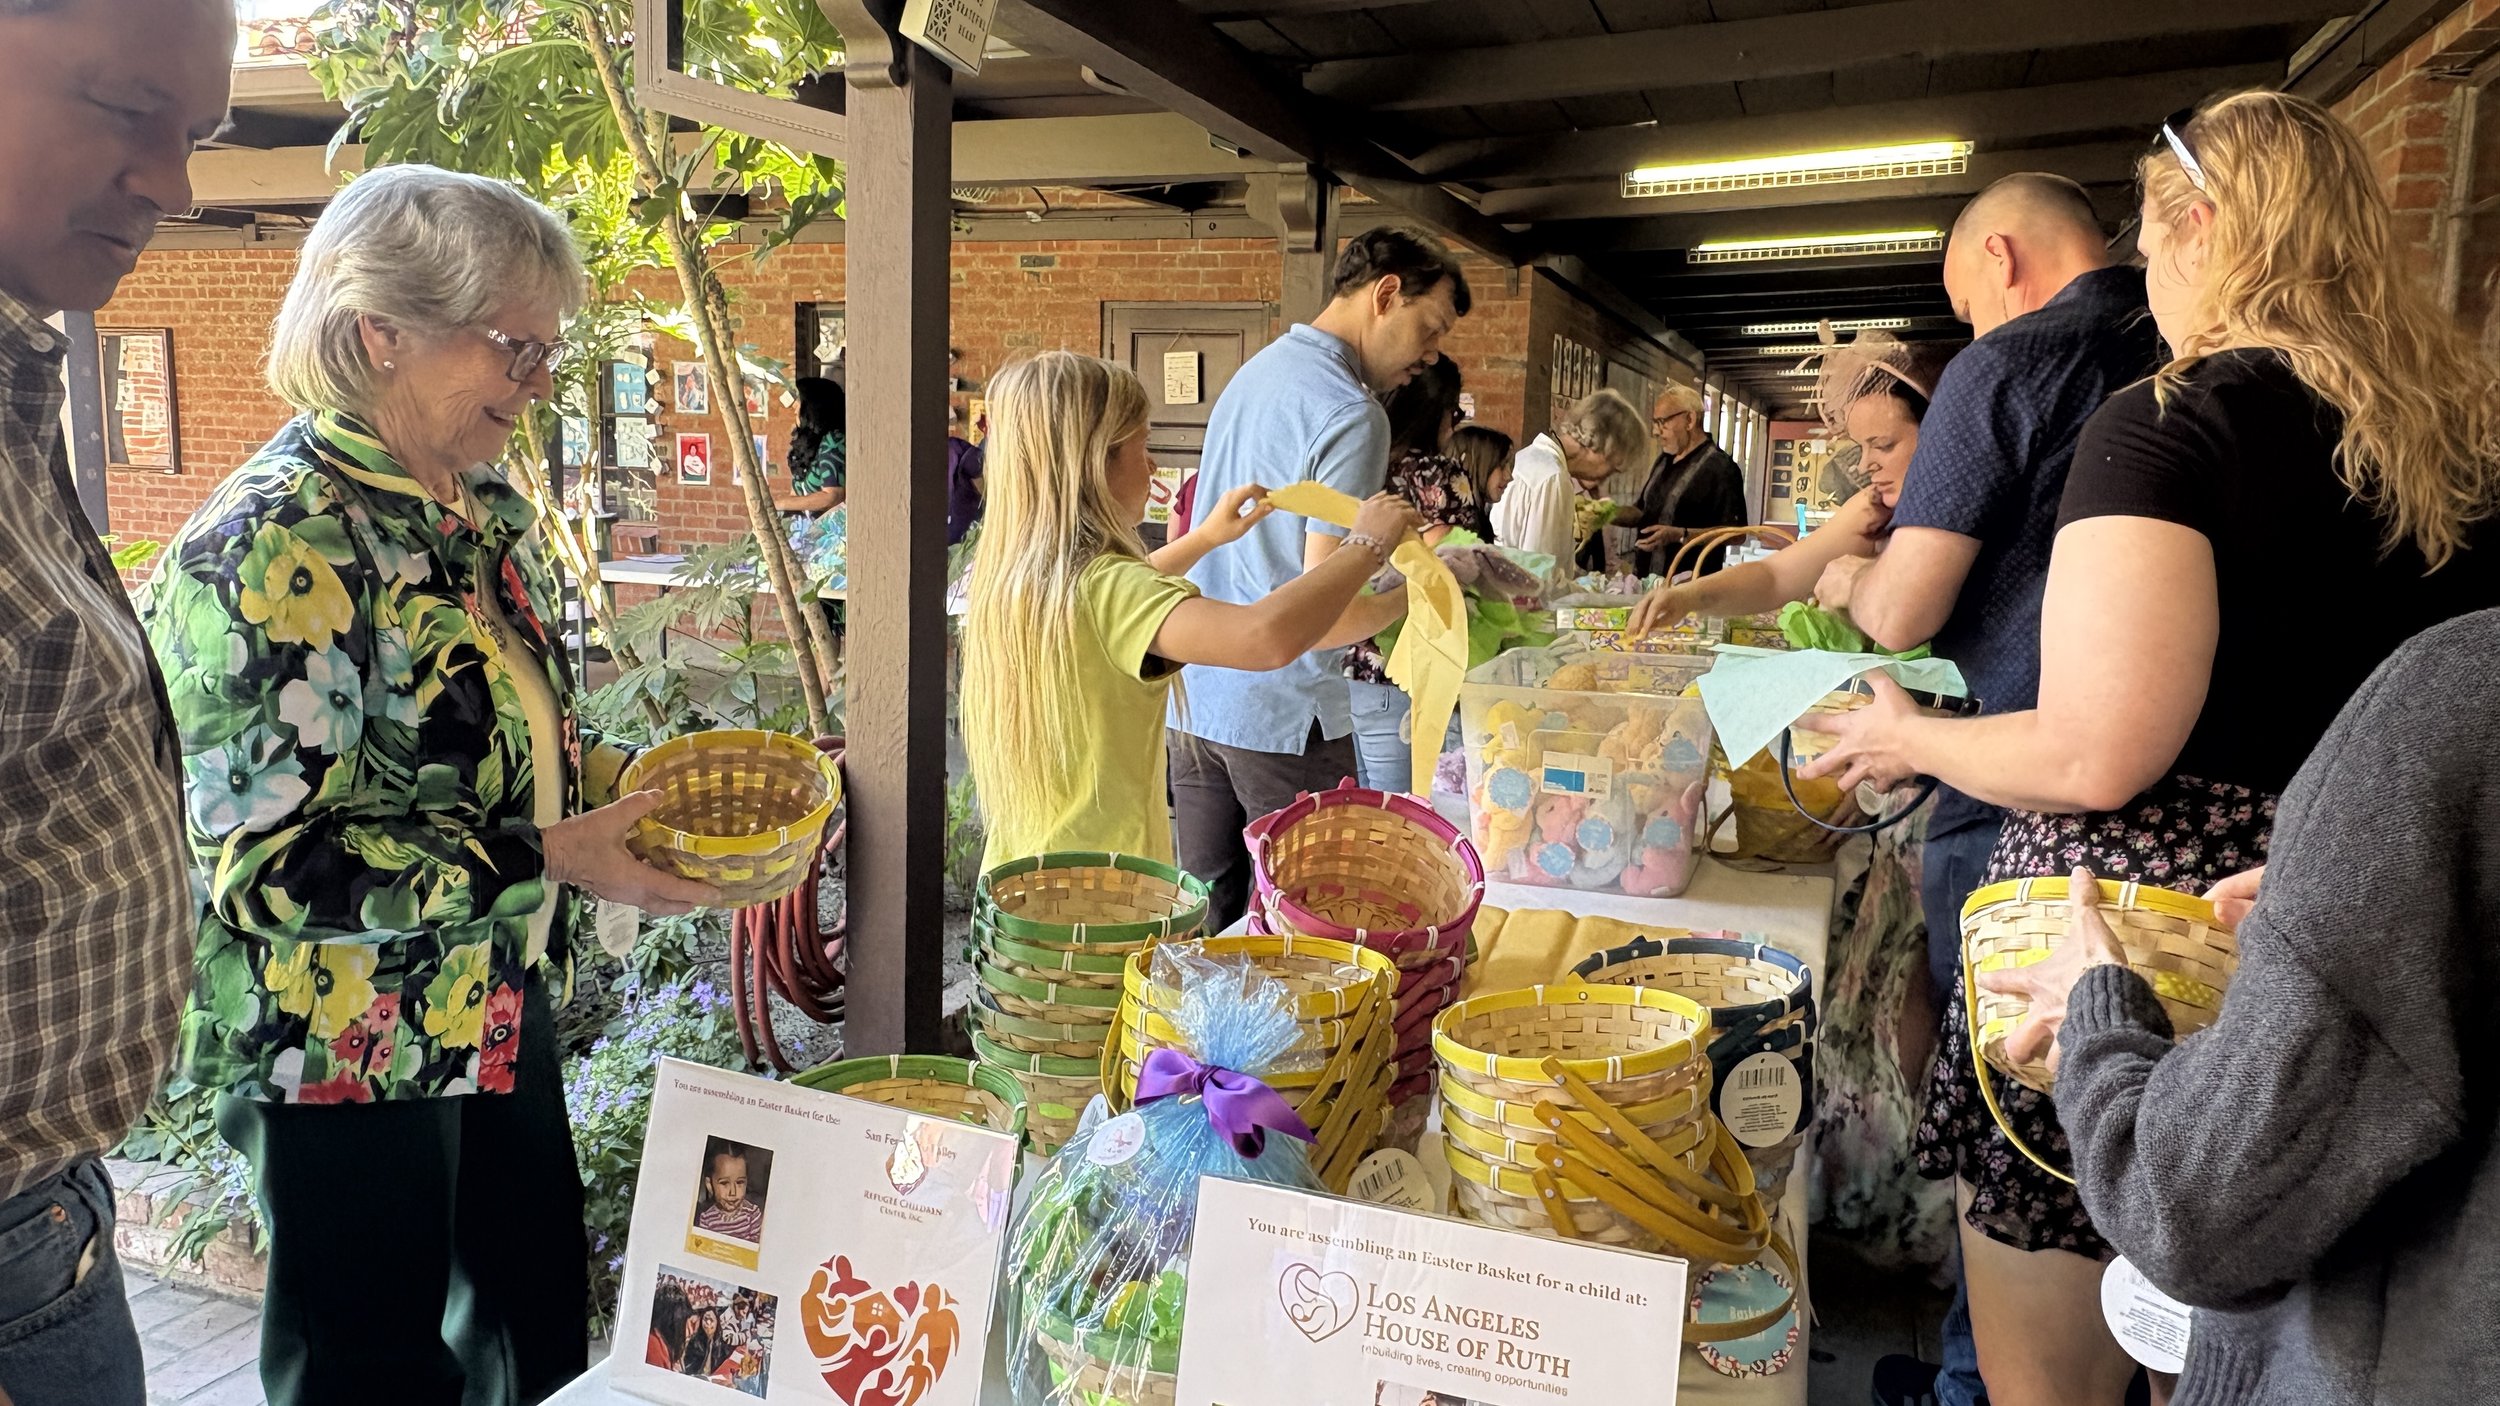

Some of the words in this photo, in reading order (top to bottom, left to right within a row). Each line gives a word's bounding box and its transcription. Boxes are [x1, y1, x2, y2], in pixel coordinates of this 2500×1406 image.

[674, 1079, 688, 1091] You
[690, 1085, 702, 1094] are
[703, 1087, 745, 1106] assembling
[746, 1097, 756, 1106] an
[758, 1098, 783, 1112] Easter
[784, 1104, 810, 1119] Basket
[812, 1110, 825, 1122] for
[865, 1128, 882, 1142] San
[864, 1190, 898, 1206] REFUGEE
[1249, 1217, 1276, 1235] You
[1280, 1226, 1304, 1240] are
[1308, 1232, 1395, 1260] assembling
[1397, 1249, 1417, 1262] an
[1422, 1251, 1473, 1273] Easter
[1477, 1261, 1531, 1285] Basket
[1536, 1273, 1561, 1289] for
[1564, 1282, 1574, 1293] a
[1579, 1282, 1621, 1301] child
[1625, 1293, 1648, 1307] at:
[1366, 1282, 1416, 1315] LOS
[1422, 1294, 1540, 1341] ANGELES
[1361, 1343, 1413, 1366] rebuilding
[1416, 1353, 1444, 1372] lives,
[1447, 1362, 1491, 1382] creating
[1494, 1371, 1569, 1397] opportunities
[1364, 1311, 1450, 1354] HOUSE
[1456, 1337, 1490, 1361] OF
[1495, 1339, 1571, 1379] RUTH
